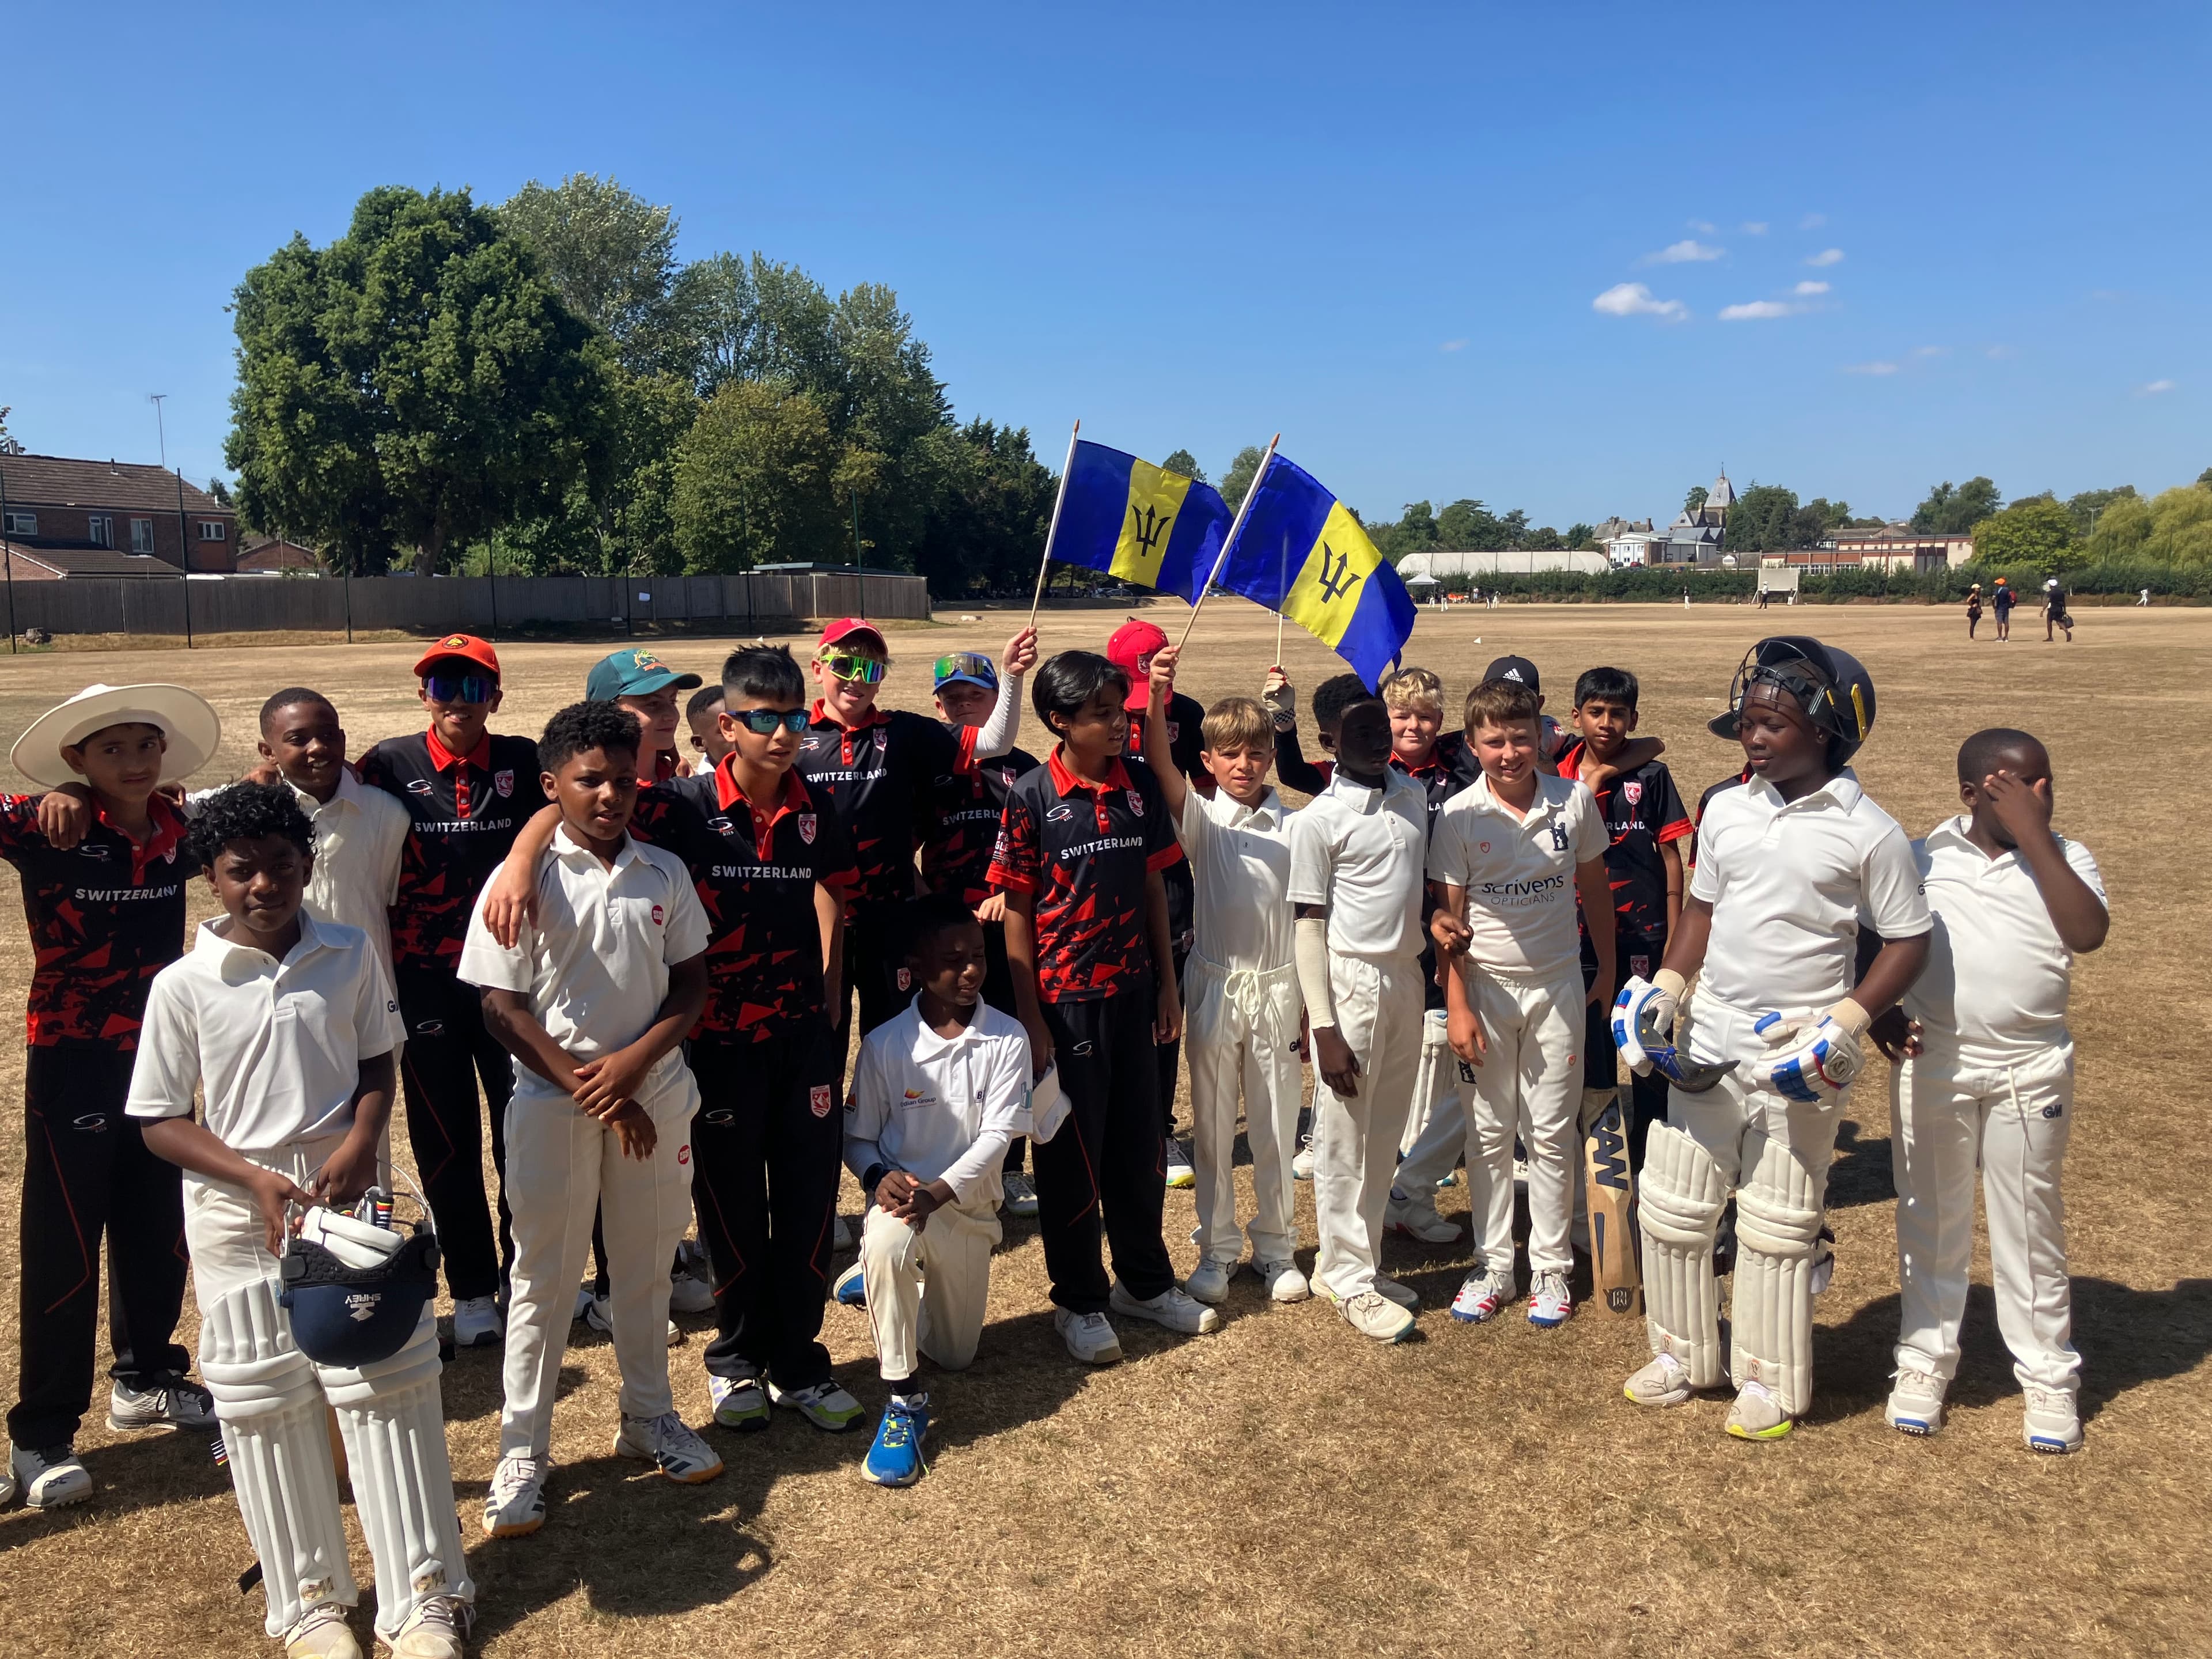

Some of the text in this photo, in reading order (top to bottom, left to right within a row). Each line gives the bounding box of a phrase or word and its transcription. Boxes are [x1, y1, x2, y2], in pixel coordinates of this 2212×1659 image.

[806, 768, 887, 782] SWITZERLAND
[415, 818, 512, 832] SWITZERLAND
[1061, 836, 1143, 859] SWITZERLAND
[711, 865, 812, 878] SWITZERLAND
[1491, 892, 1555, 906] OPTICIANS
[2042, 1104, 2062, 1119] GM
[344, 1293, 381, 1304] SHREY
